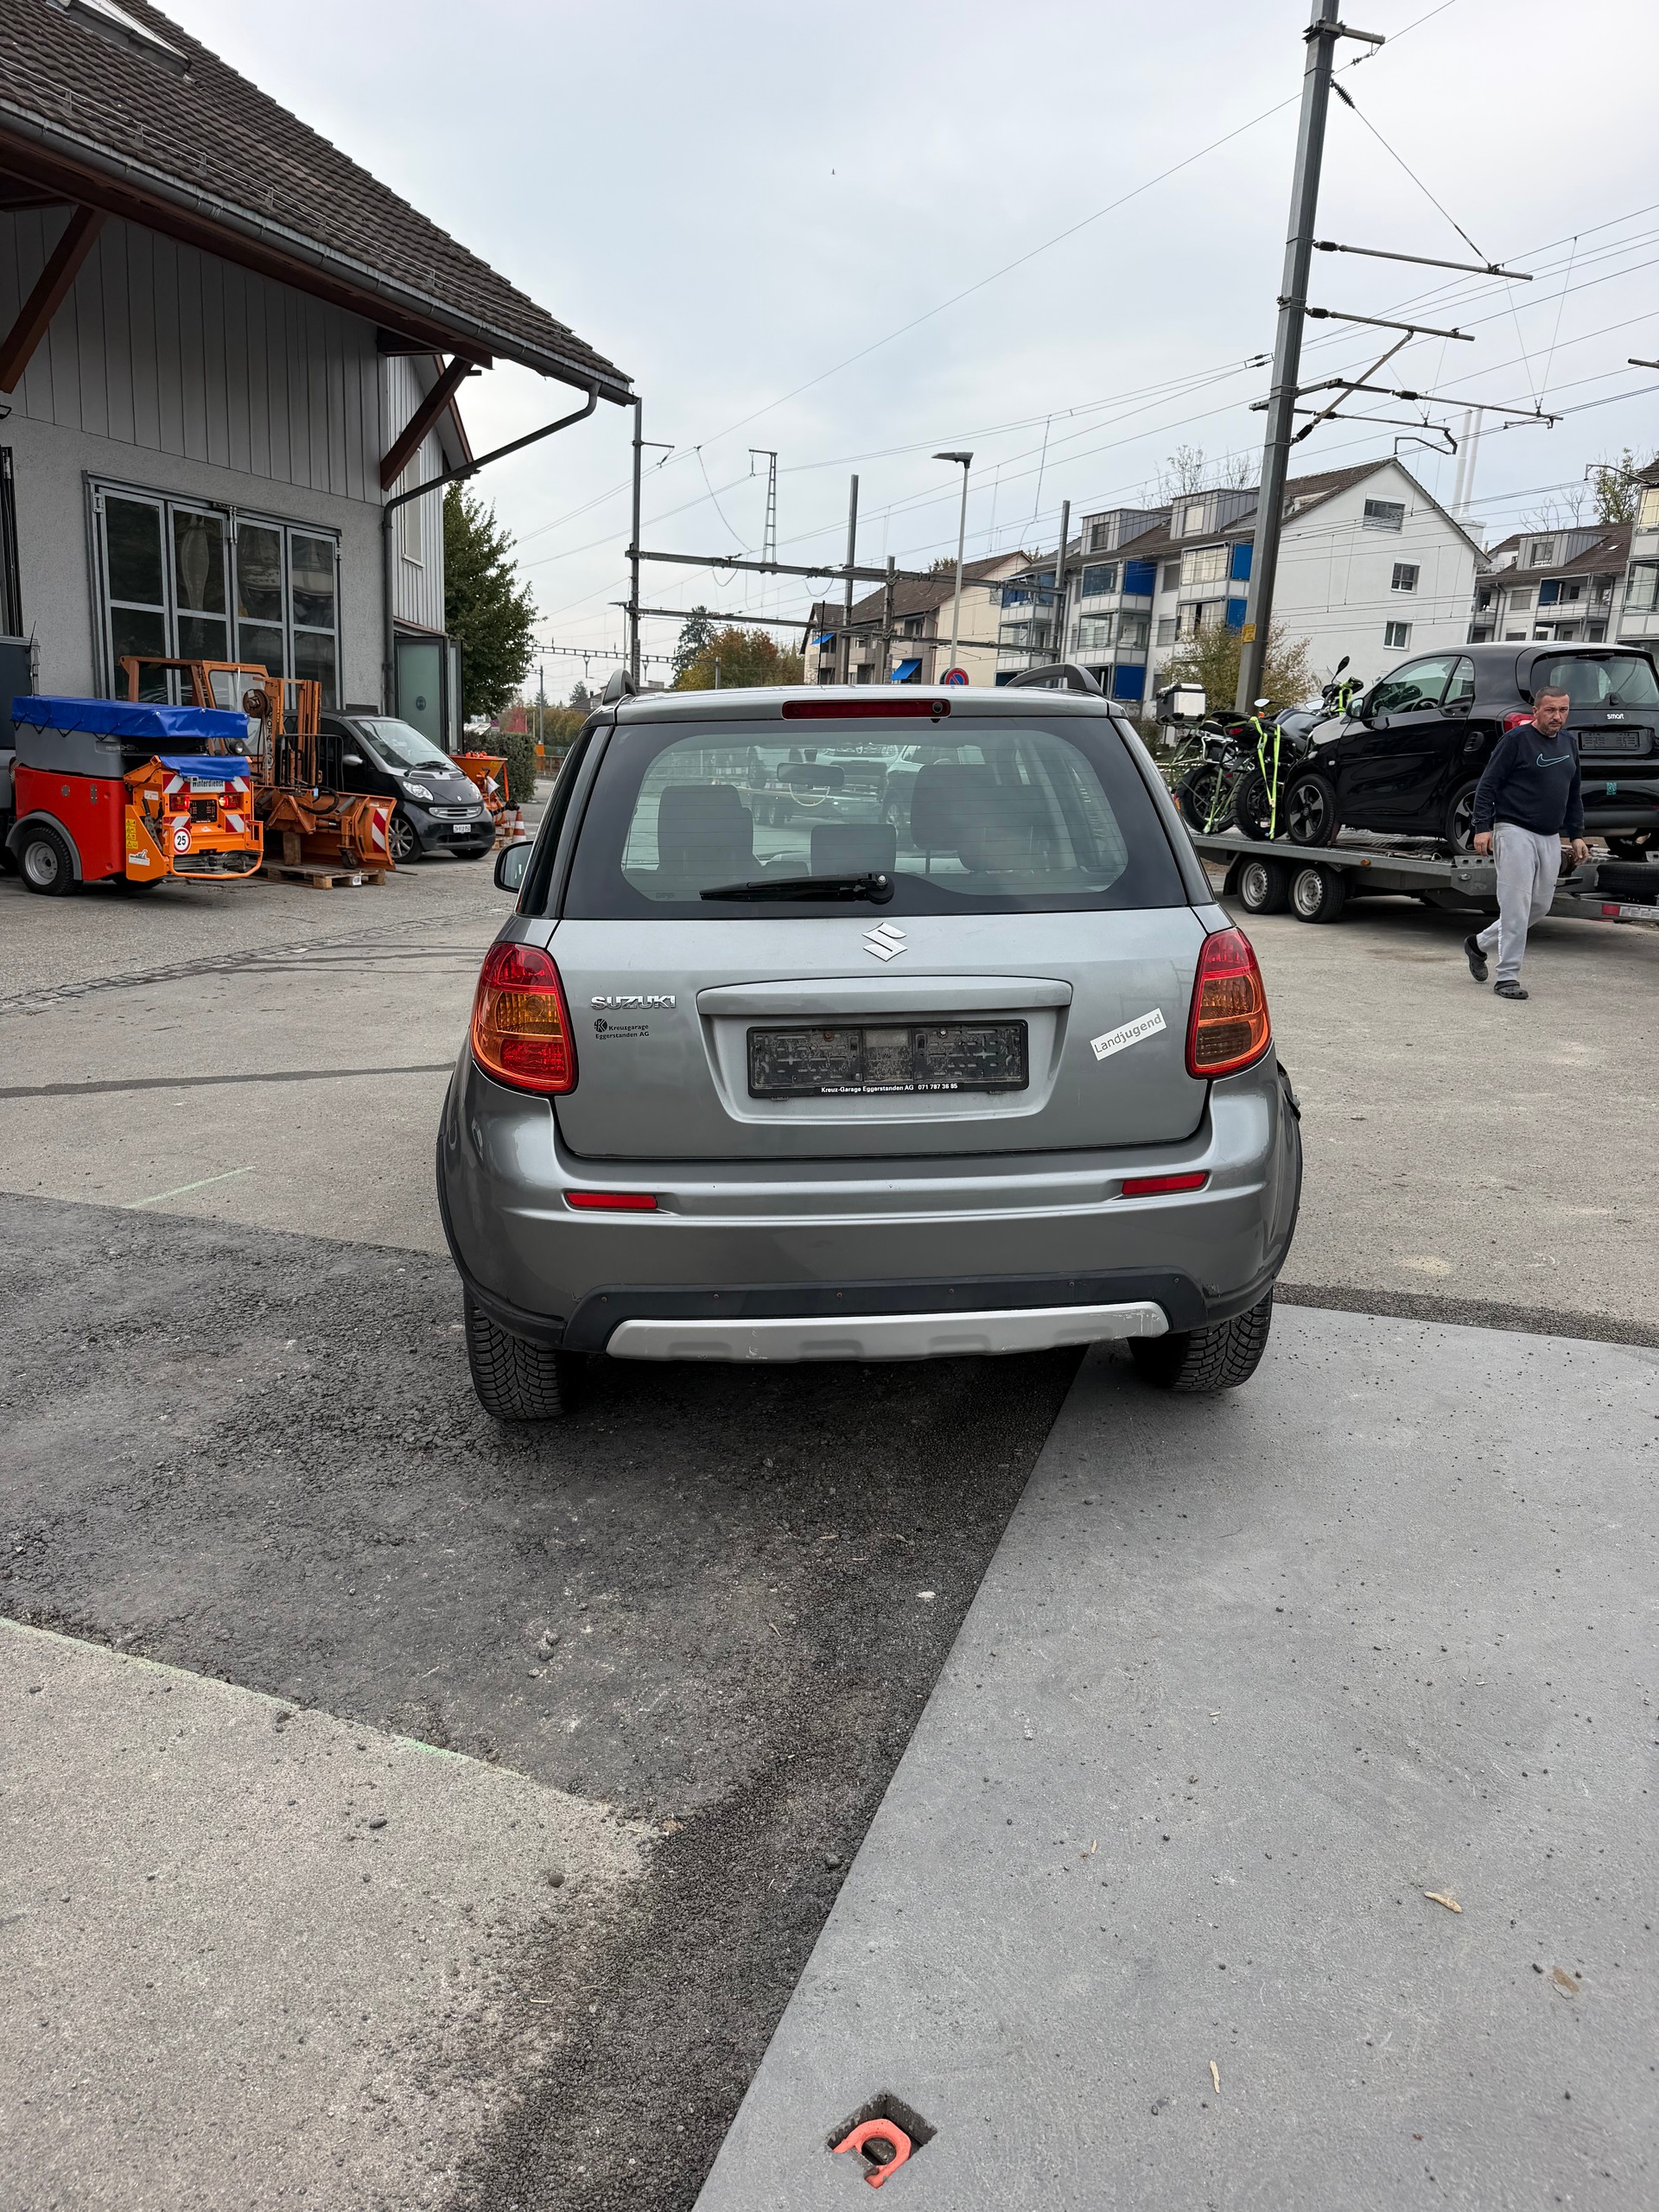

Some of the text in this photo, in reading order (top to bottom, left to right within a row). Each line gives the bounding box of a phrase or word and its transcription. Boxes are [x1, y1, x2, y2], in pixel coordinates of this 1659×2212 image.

[177, 836, 187, 846] 25
[591, 995, 676, 1010] SUZUKI
[1094, 1014, 1161, 1053] Landjugend
